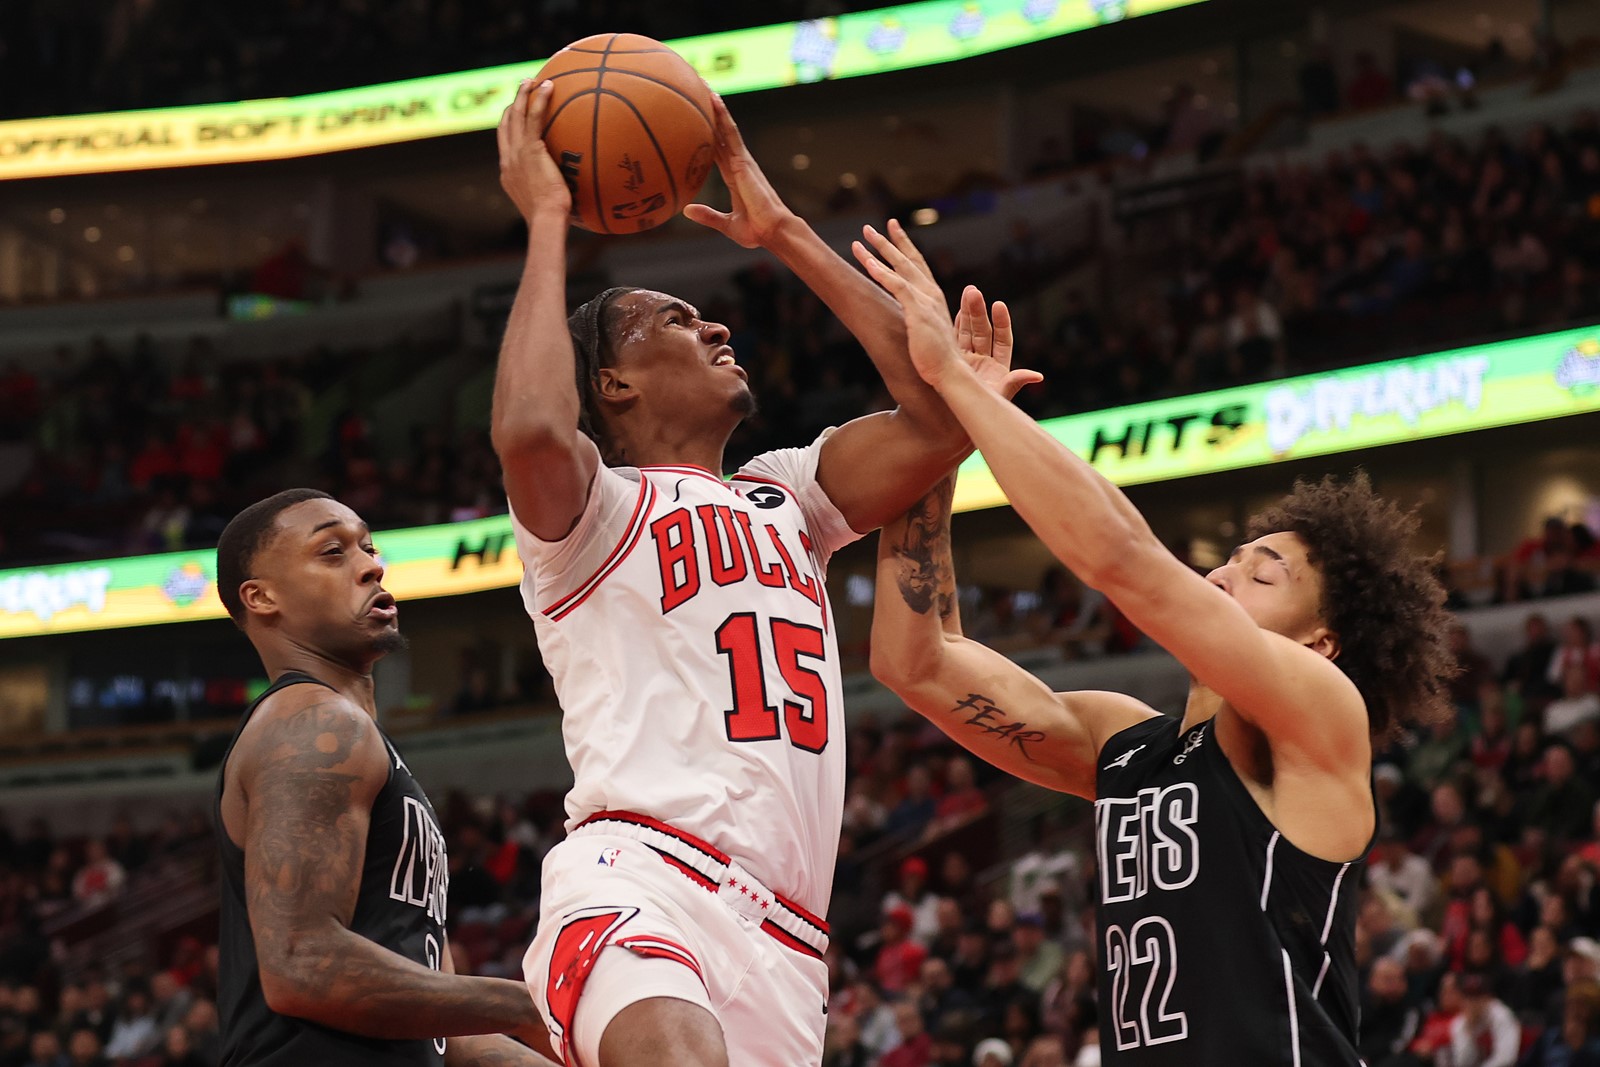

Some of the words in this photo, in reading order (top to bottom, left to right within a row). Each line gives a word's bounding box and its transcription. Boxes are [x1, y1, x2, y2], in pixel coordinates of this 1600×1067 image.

[1089, 404, 1249, 463] HITS
[714, 611, 829, 755] 15
[951, 693, 1046, 761] FEAR
[1094, 782, 1200, 904] ETS
[1105, 915, 1188, 1051] 22
